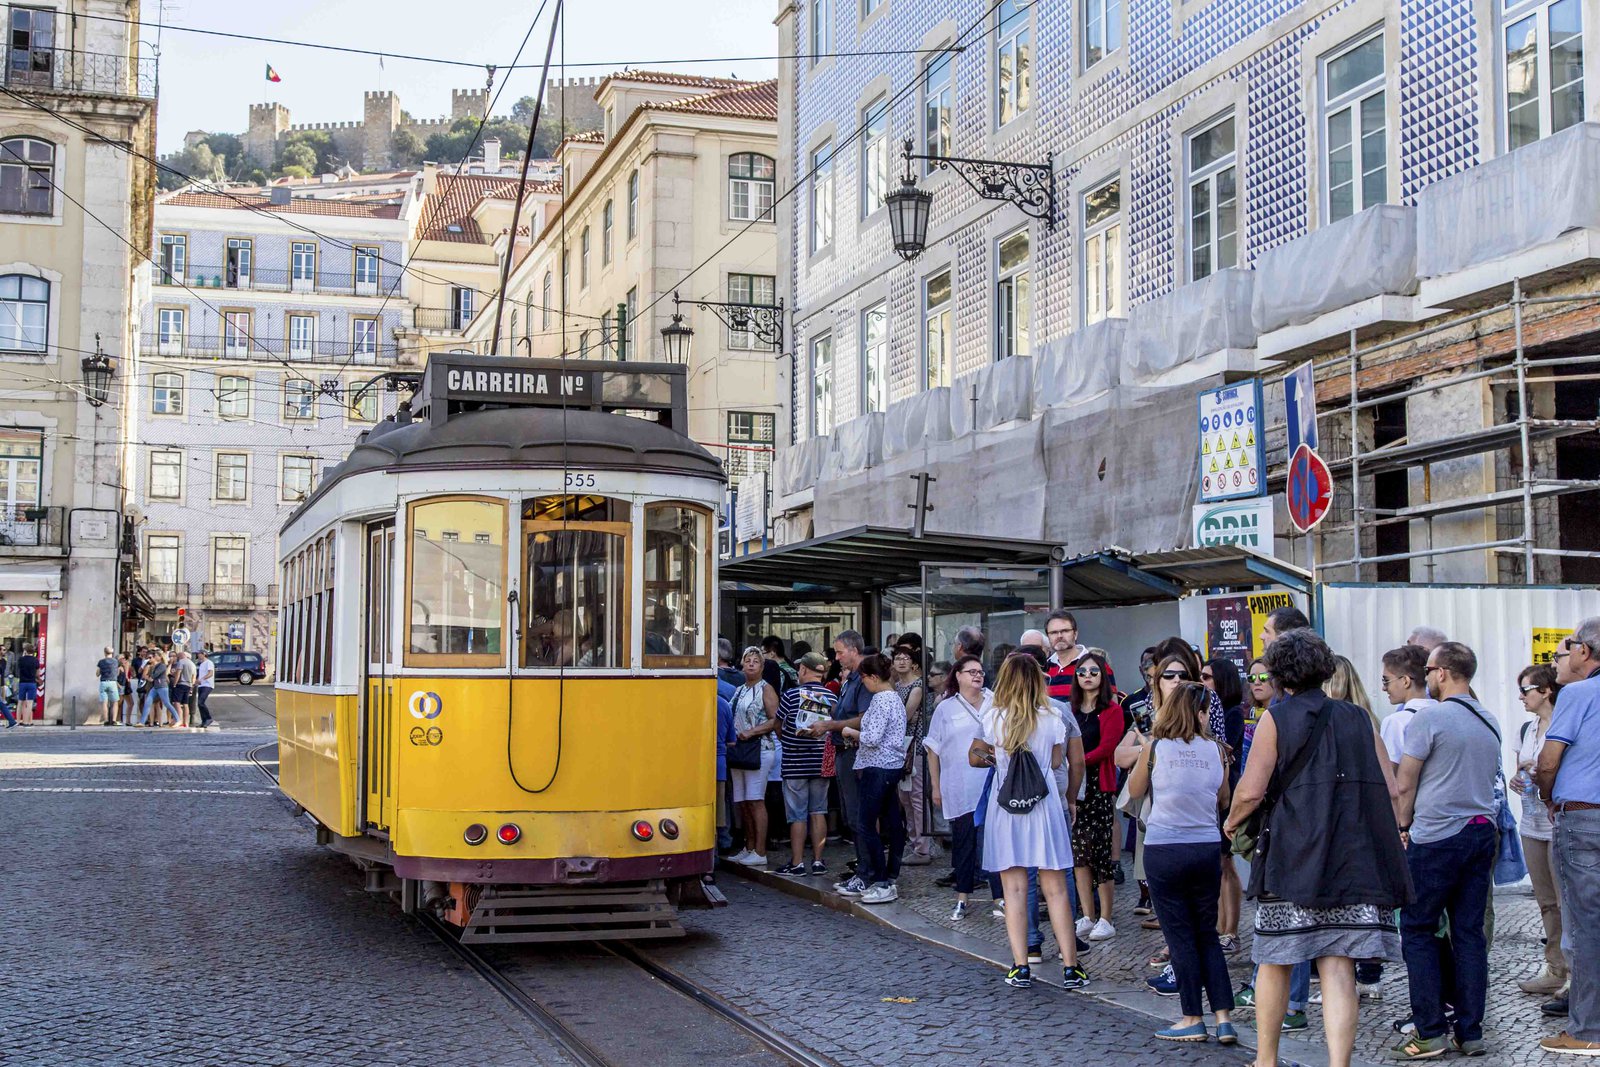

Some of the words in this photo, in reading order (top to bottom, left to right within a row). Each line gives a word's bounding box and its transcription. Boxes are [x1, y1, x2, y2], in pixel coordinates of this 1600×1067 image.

[448, 370, 548, 394] CARREIRA
[560, 375, 584, 396] Nº
[564, 472, 595, 487] 555
[1204, 513, 1259, 547] DDN
